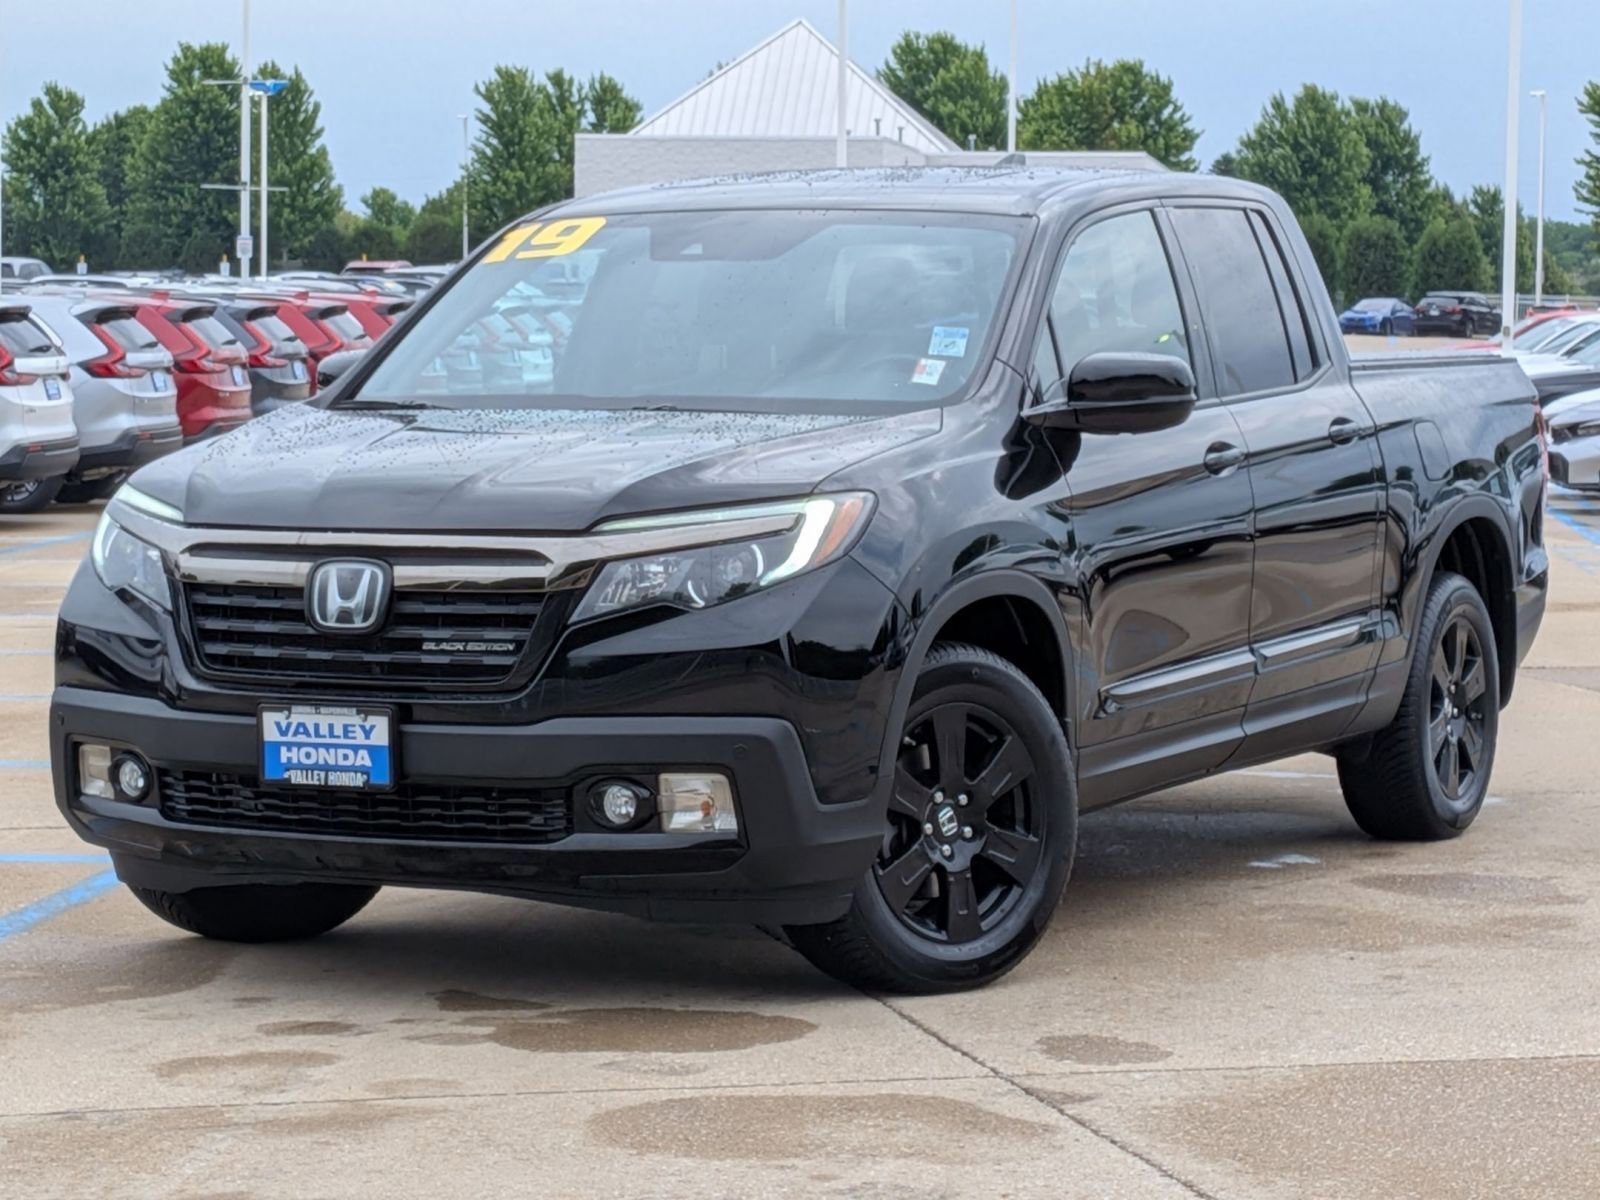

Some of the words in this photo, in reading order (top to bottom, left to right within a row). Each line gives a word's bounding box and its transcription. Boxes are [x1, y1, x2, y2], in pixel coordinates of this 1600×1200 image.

[480, 216, 607, 264] 19
[422, 641, 465, 651] BLACK
[466, 641, 516, 651] EDITION
[274, 720, 377, 740] VALLEY
[279, 746, 373, 767] HONDA
[289, 769, 326, 786] VALLEY
[327, 771, 364, 788] HONDA
